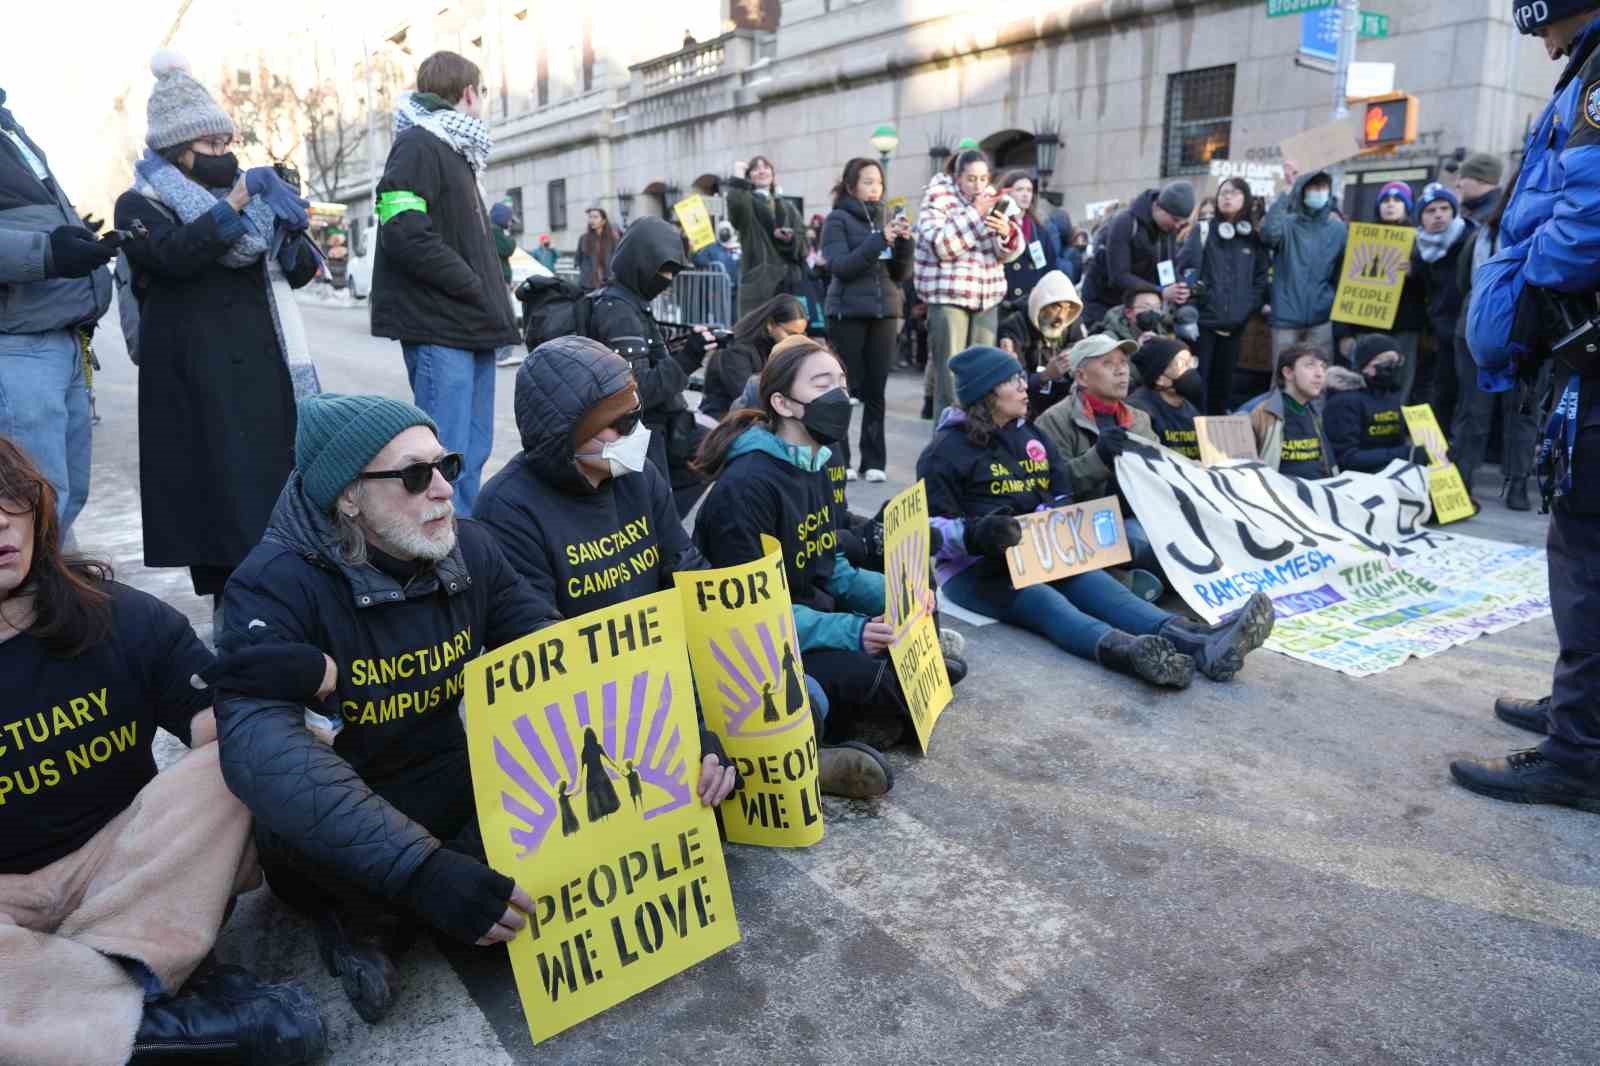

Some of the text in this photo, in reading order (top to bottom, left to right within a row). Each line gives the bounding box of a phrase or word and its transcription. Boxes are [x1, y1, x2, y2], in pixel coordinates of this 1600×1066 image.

[1353, 225, 1408, 242] FOR THE
[1342, 286, 1393, 304] PEOPLE
[1357, 303, 1388, 321] LOVE
[696, 571, 771, 612] FOR
[351, 624, 472, 686] SANCTUARY
[484, 606, 663, 706] FOR THE
[342, 686, 441, 724] CAMPUS
[65, 720, 137, 775] NOW
[738, 791, 789, 829] WE
[528, 828, 704, 941] PEOPLE
[536, 876, 716, 1002] WE LOVE
